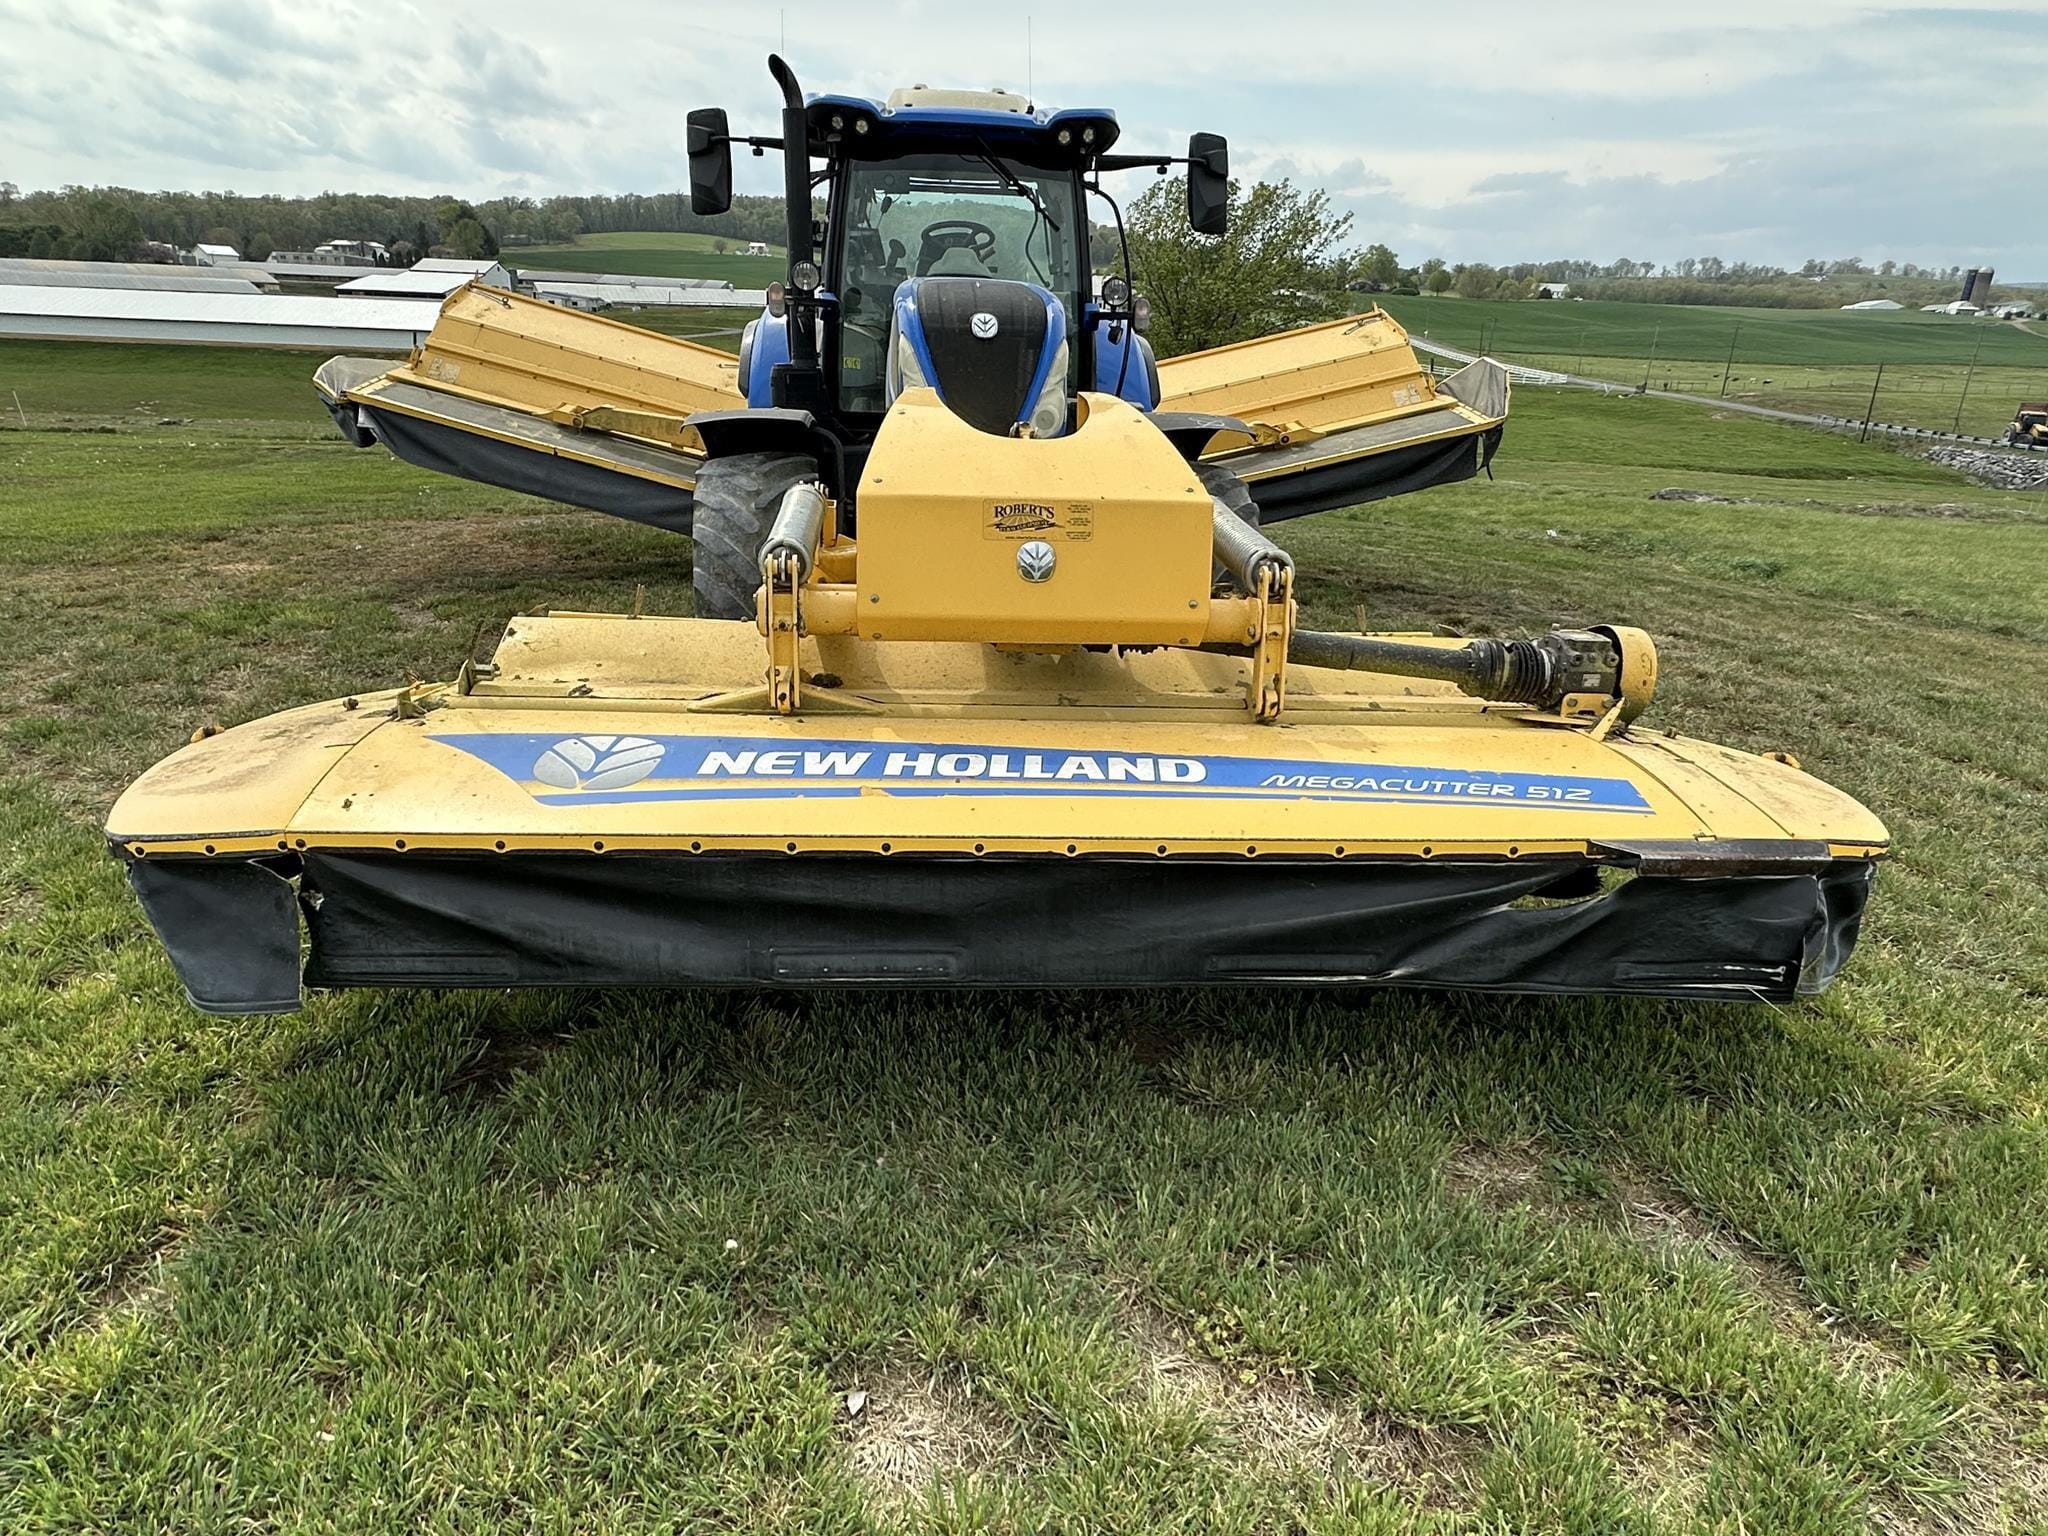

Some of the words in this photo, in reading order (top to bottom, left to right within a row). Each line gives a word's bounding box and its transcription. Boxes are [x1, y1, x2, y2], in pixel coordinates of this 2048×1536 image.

[697, 751, 872, 776] NEW
[882, 753, 1208, 783] HOLLAND
[1261, 775, 1514, 797] MEGACUTTER
[1526, 787, 1592, 800] 512
